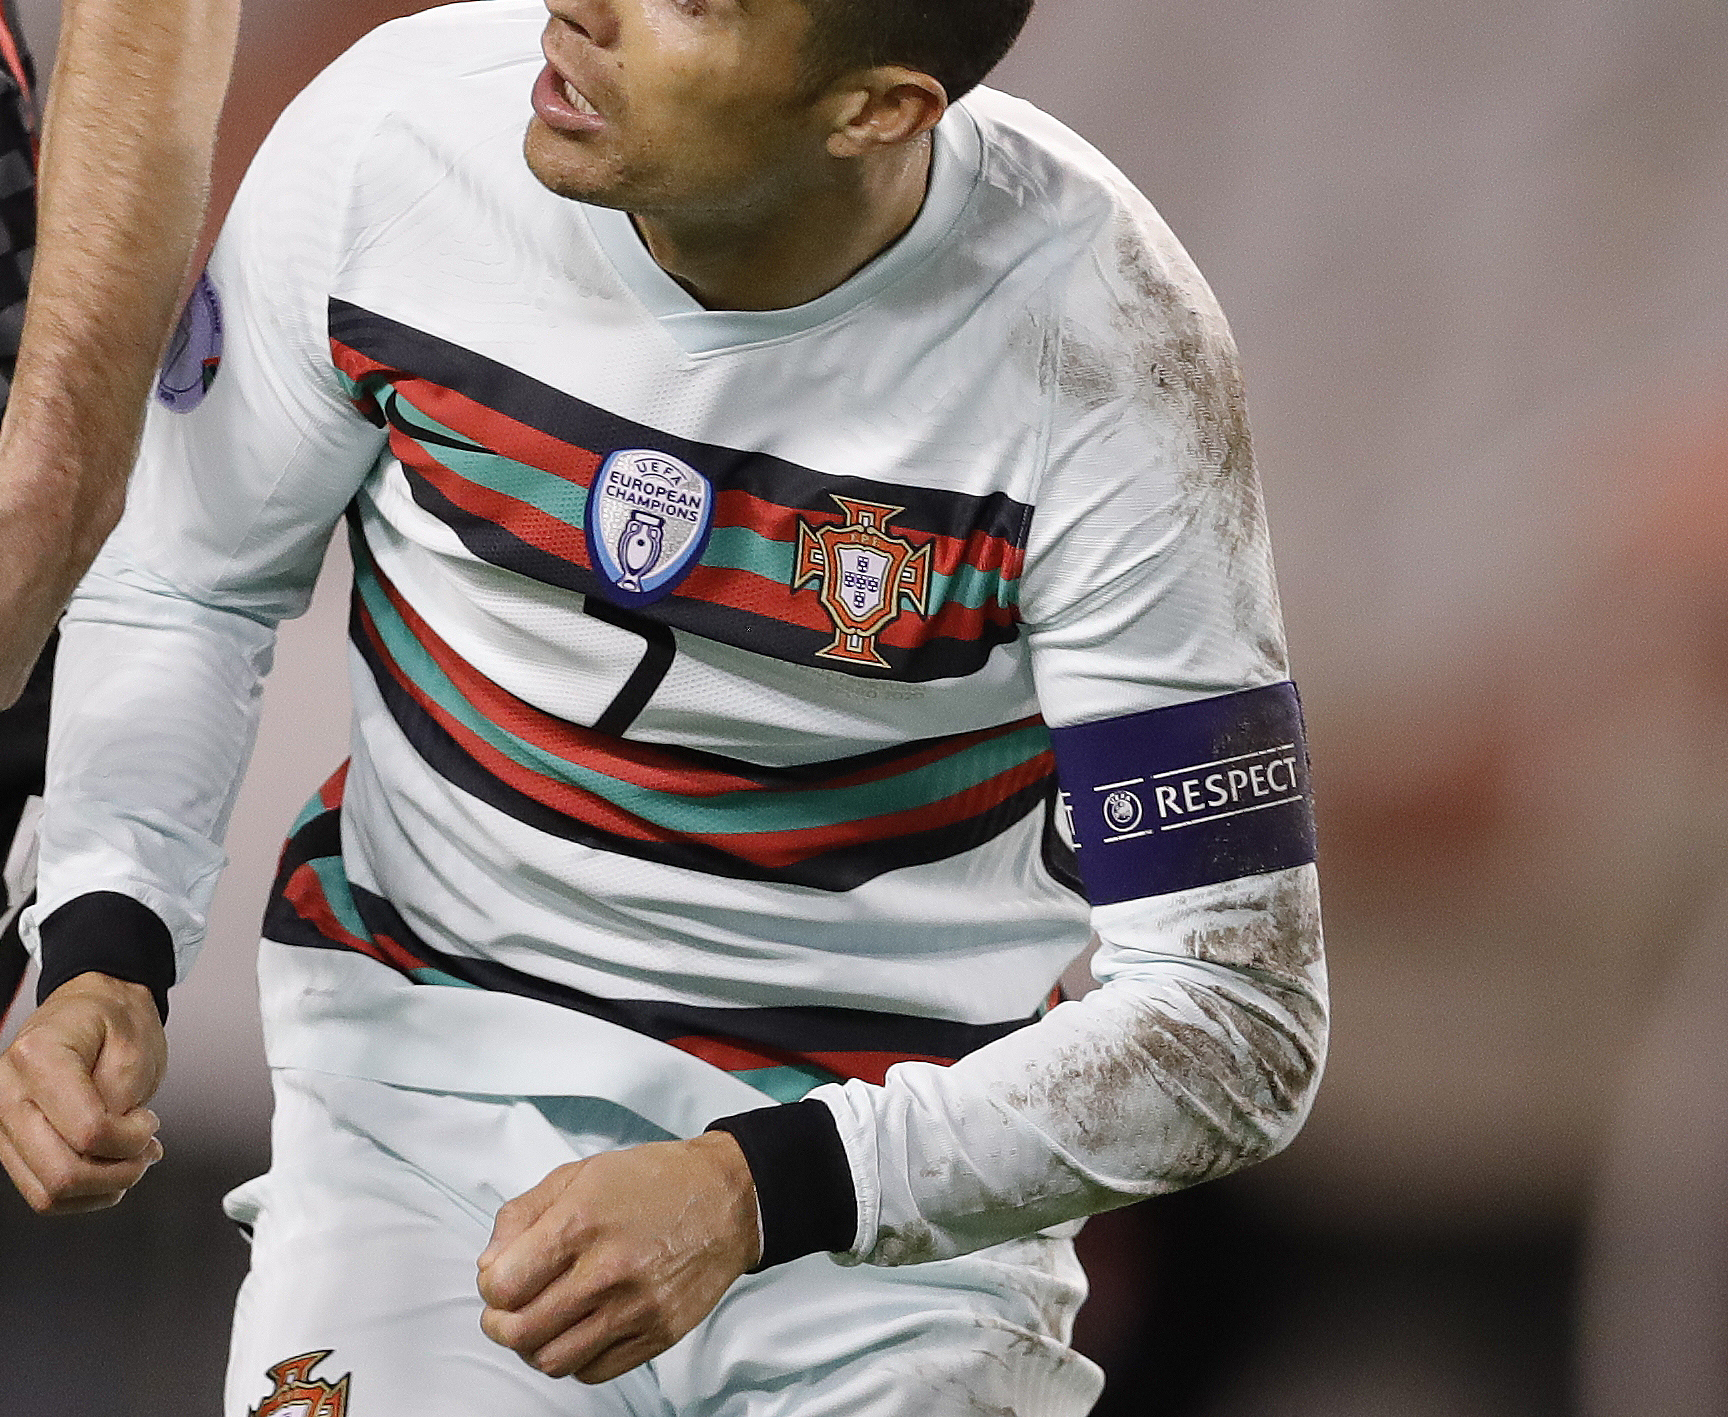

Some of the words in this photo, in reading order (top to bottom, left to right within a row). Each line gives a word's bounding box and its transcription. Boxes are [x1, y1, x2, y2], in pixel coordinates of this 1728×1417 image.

[610, 470, 702, 510] EUROPEAN
[636, 462, 682, 486] UEFA
[606, 485, 699, 522] CHAMPIONS
[583, 593, 676, 739] 7
[1154, 757, 1298, 819] RESPECT
